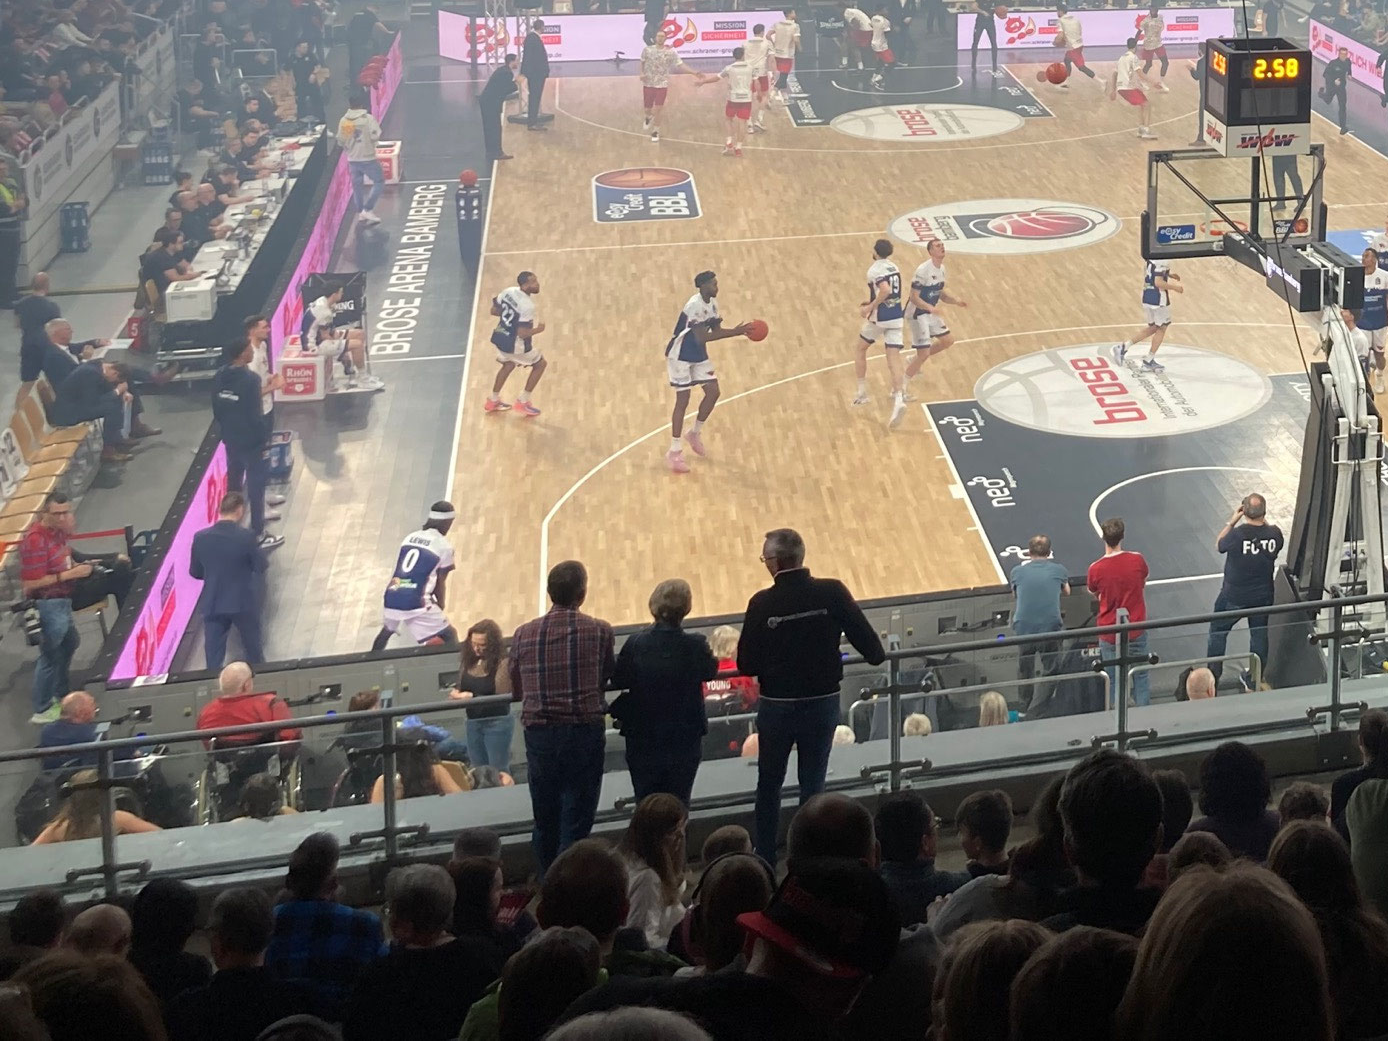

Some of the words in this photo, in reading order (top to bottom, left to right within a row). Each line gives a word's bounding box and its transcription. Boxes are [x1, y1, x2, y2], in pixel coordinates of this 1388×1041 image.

[702, 32, 746, 41] SICHERHEIT
[715, 21, 746, 30] MISSION
[1253, 57, 1299, 79] 2.58
[897, 109, 938, 137] brose
[400, 183, 448, 244] BAMBERG
[647, 191, 691, 216] BBL
[908, 217, 936, 243] brose
[1170, 230, 1195, 240] Credit
[386, 244, 434, 294] ARENA
[130, 322, 139, 337] 5
[369, 297, 421, 356] BROSE
[1069, 356, 1148, 425] brose
[946, 416, 983, 443] neo
[975, 477, 1016, 507] neo
[409, 536, 432, 547] LEWIS
[401, 548, 420, 574] 0
[706, 680, 731, 691] YOUNG
